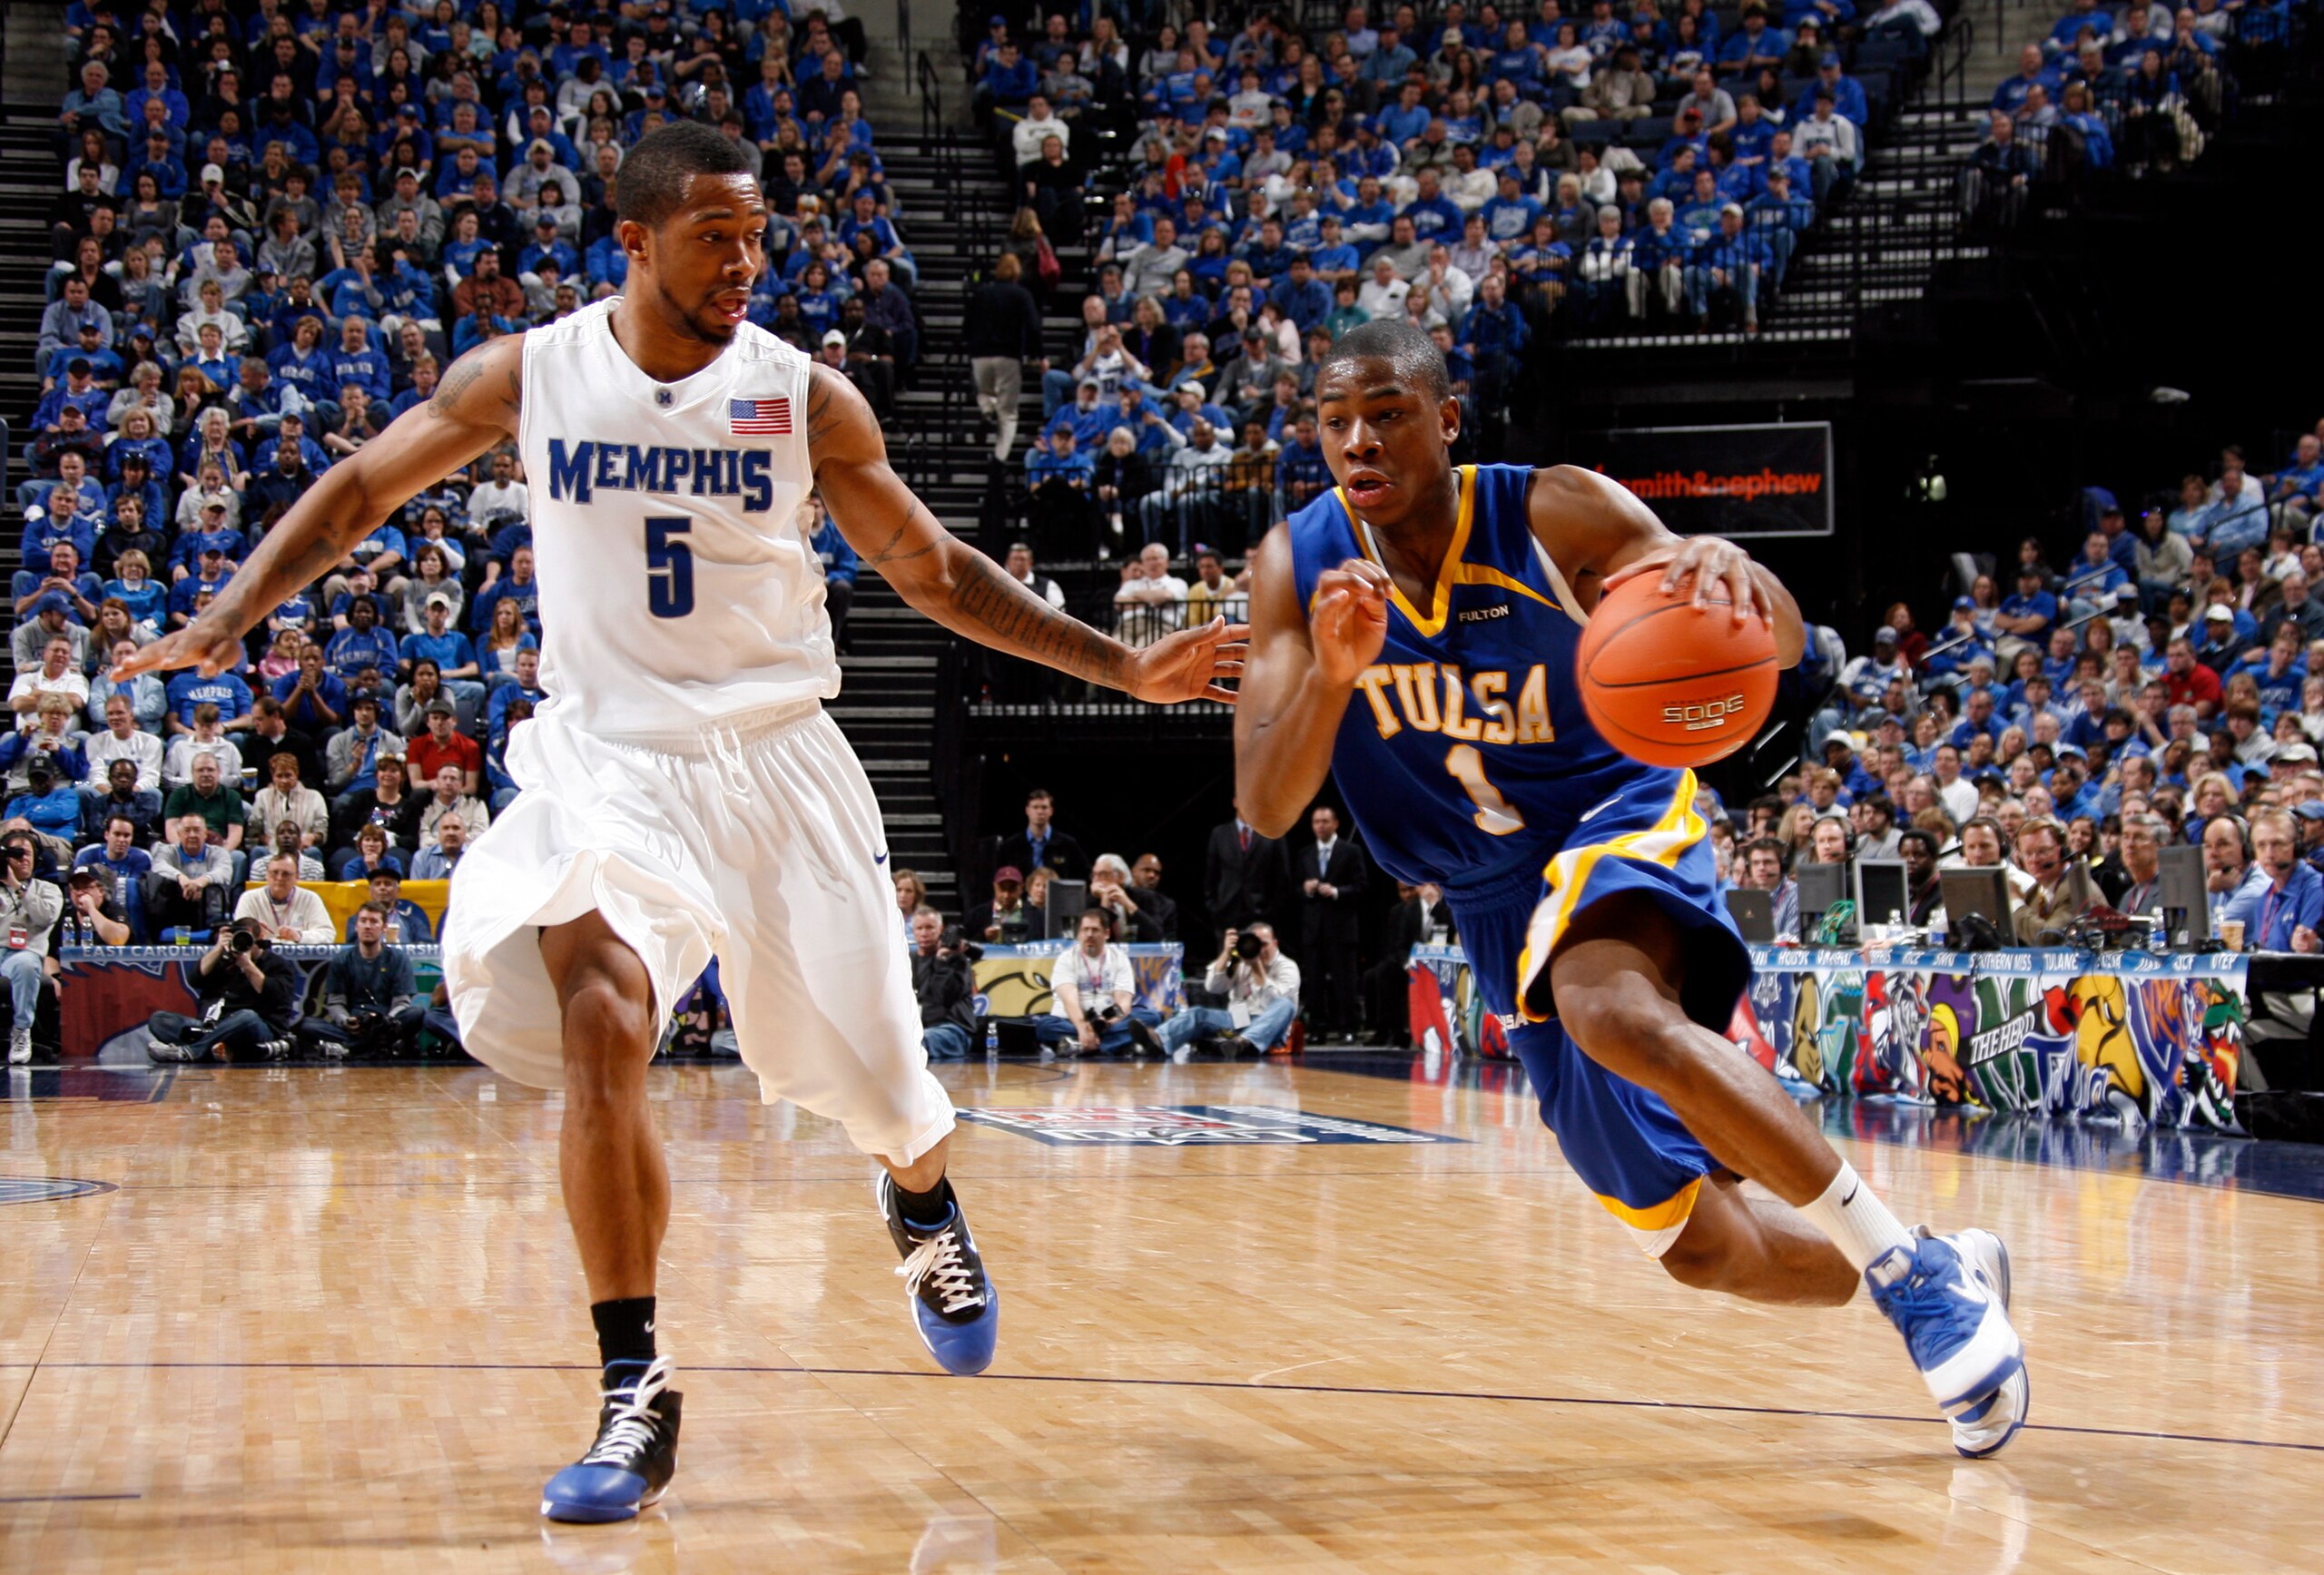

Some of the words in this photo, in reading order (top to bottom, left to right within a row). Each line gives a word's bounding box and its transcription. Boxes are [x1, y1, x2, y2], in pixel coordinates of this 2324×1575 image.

[659, 392, 672, 404] M
[547, 438, 773, 513] MEMPHIS
[644, 516, 694, 618] 5
[1458, 605, 1509, 622] FULTON
[187, 685, 233, 700] MEMPHIS
[1353, 662, 1555, 745] TULSA
[1443, 743, 1526, 836] 1
[83, 945, 126, 957] EAST
[130, 945, 209, 957] CAROLIN
[271, 944, 340, 956] OUSTON
[1016, 943, 1063, 954] TULSA
[1968, 951, 2013, 970] SUTHERN
[2043, 952, 2079, 970] TULANE
[1970, 1026, 2002, 1065] THE
